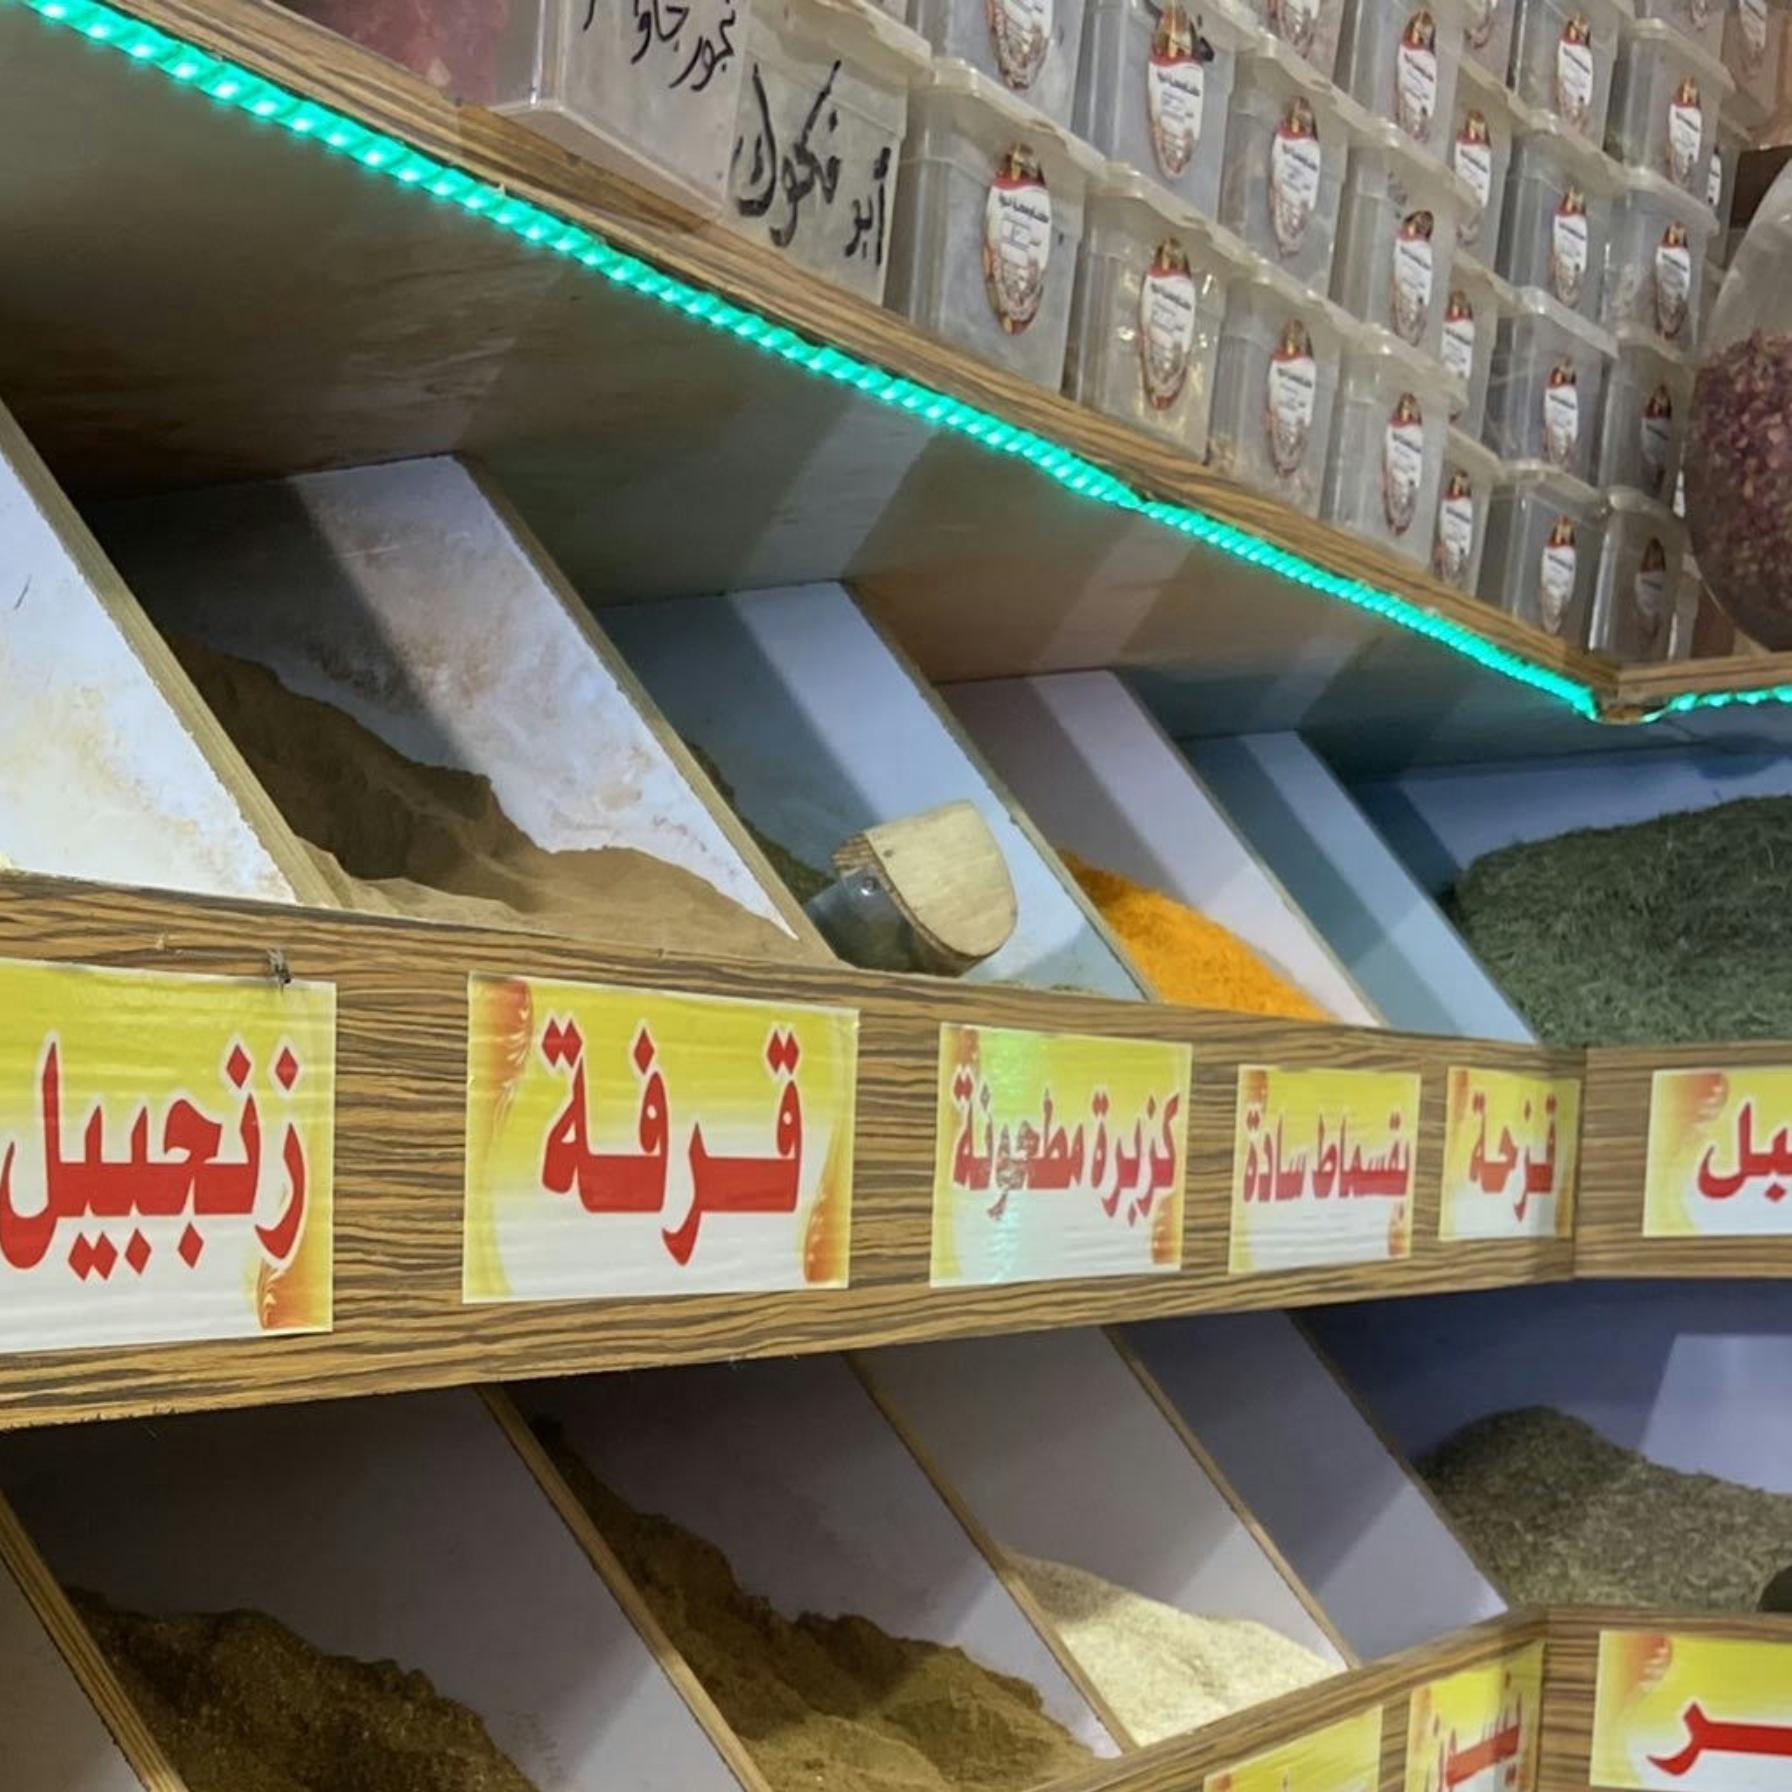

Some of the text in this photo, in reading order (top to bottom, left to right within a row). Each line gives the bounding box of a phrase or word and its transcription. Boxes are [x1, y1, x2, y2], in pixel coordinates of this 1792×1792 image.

[543, 1023, 802, 1264] قرفة
[1090, 1091, 1181, 1228] كزبرة
[1241, 1108, 1414, 1222] بقسماط سادة
[1467, 1092, 1560, 1224] قزحة
